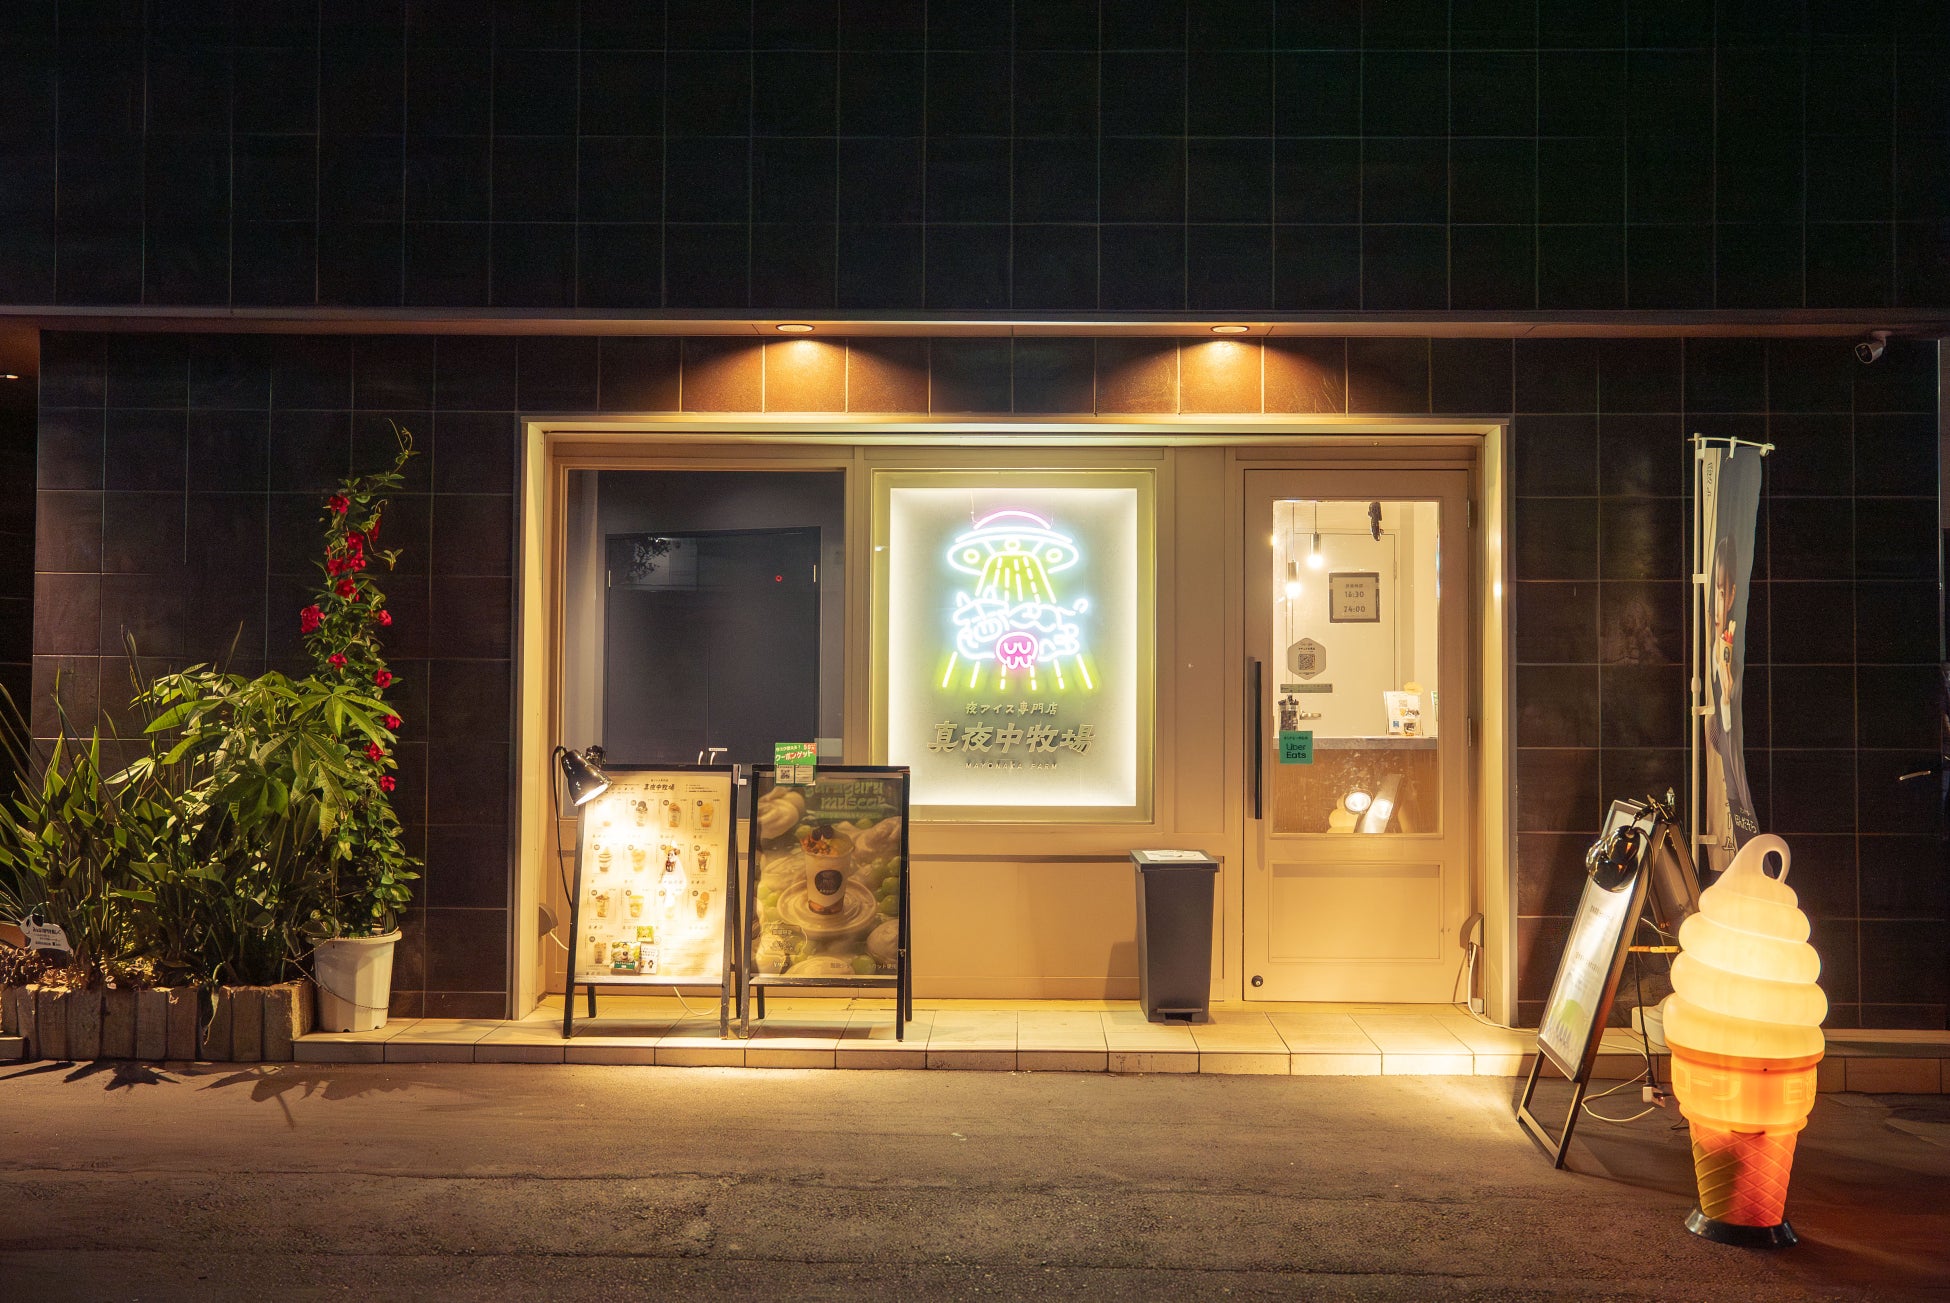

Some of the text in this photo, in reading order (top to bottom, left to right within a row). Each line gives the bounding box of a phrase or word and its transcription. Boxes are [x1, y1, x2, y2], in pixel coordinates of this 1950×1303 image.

[965, 701, 1059, 715] 夜アイス専門店
[927, 720, 1097, 756] 真夜中牧場
[1286, 743, 1307, 751] Uber
[1286, 751, 1307, 759] Eats
[965, 762, 1059, 770] MAYONAKA FARM
